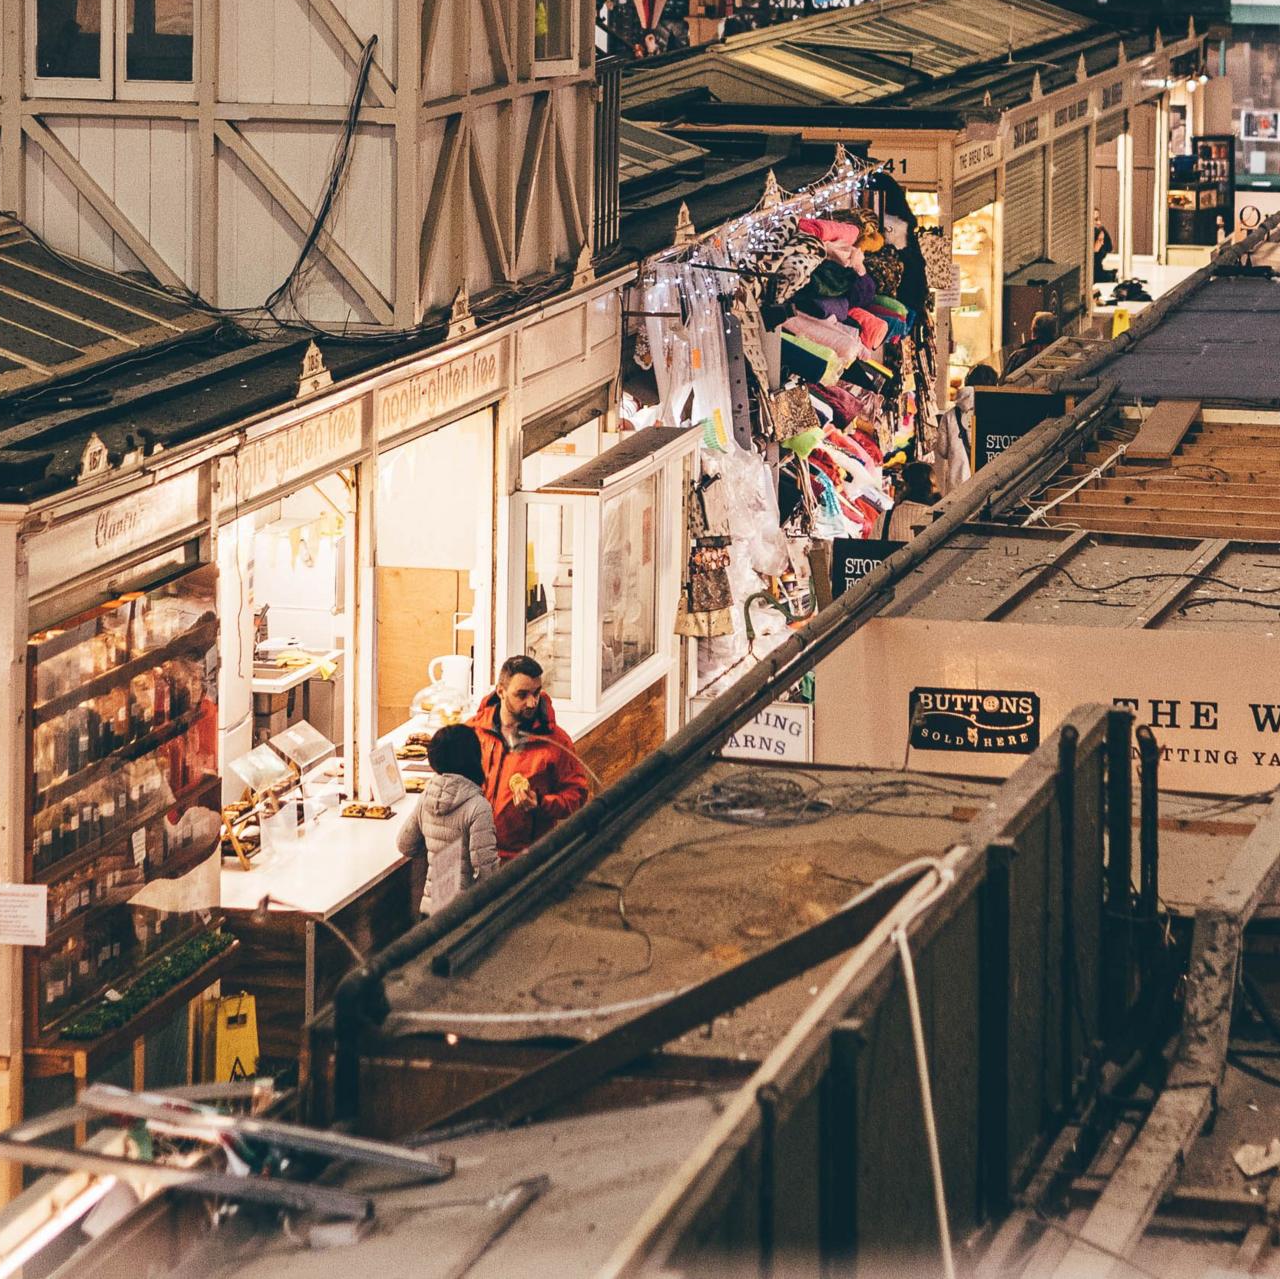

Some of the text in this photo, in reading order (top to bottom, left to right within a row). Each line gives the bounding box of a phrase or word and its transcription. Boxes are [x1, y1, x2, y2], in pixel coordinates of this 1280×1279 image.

[959, 144, 994, 170] THE BREAD STALL
[473, 352, 496, 393] free
[327, 406, 356, 443] free
[919, 693, 1033, 715] BUTTONS
[728, 734, 786, 757] ARNS
[921, 728, 1030, 748] SOLD HERE
